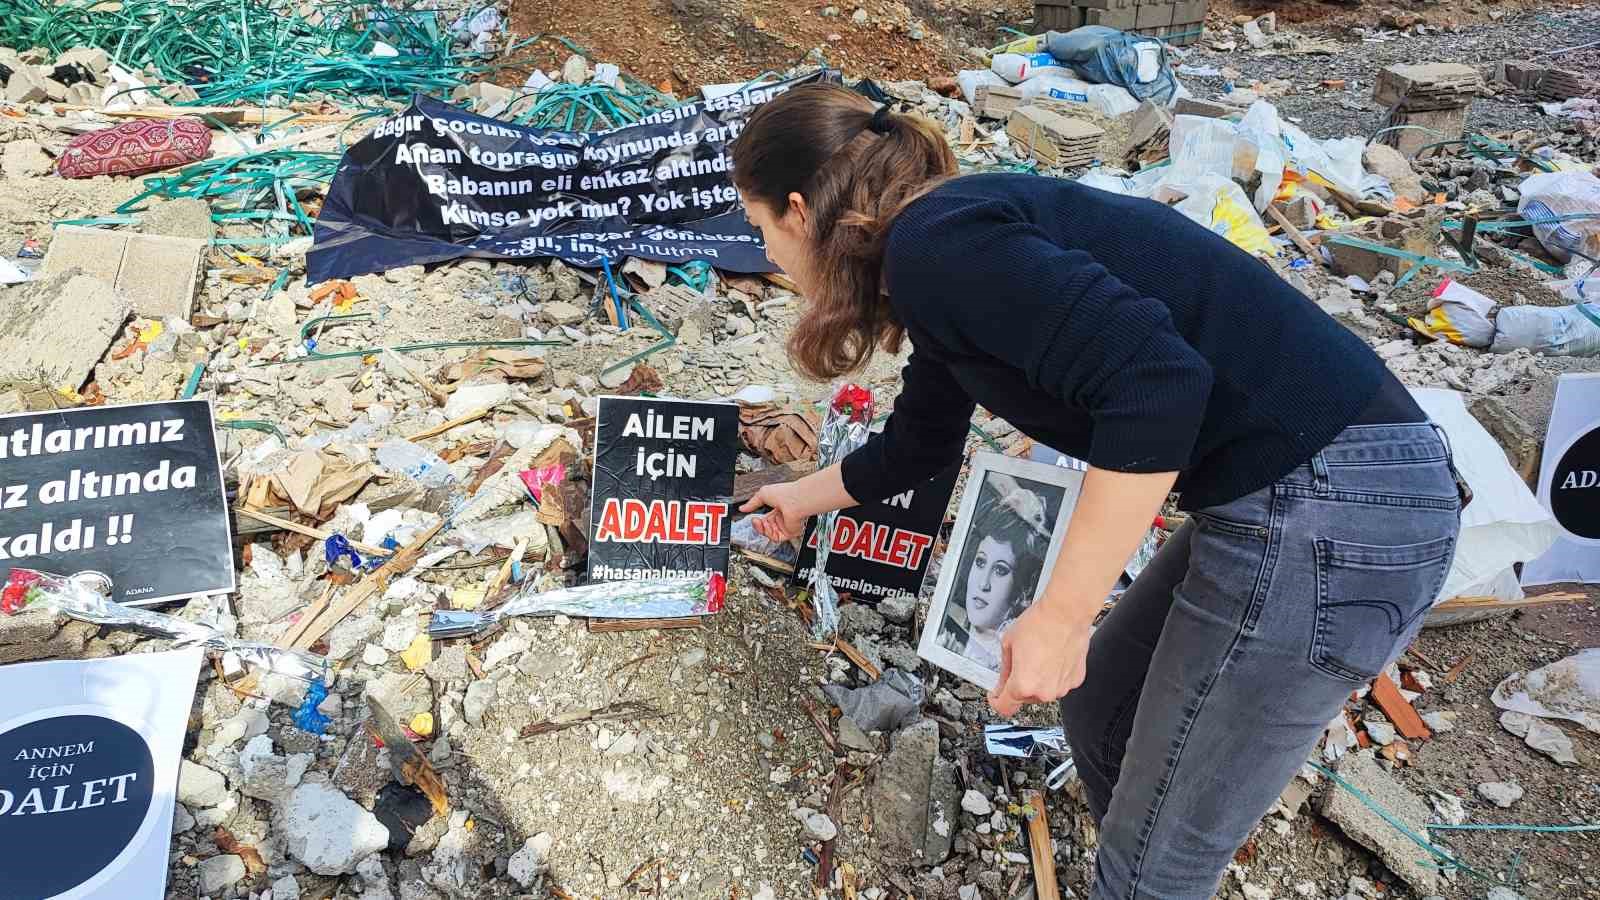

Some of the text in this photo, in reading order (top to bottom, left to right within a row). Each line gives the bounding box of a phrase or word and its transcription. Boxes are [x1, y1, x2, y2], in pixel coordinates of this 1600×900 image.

[395, 143, 461, 165] Anan
[470, 146, 577, 169] toprağın
[584, 130, 699, 163] koynunda
[428, 175, 533, 196] Babanın
[541, 175, 572, 191] eli
[580, 167, 651, 191] enkaz
[440, 200, 521, 227] Kimse
[527, 201, 574, 227] yok
[581, 196, 632, 218] mu?
[638, 188, 686, 212] Yok
[0, 419, 184, 459] tlarımız
[622, 408, 715, 441] AİLEM
[636, 446, 697, 481] İÇİN
[1560, 470, 1600, 489] AD
[38, 460, 197, 505] altında
[106, 513, 135, 546] !!
[595, 498, 729, 545] ADALET
[14, 741, 95, 761] ANNEM
[28, 763, 74, 781] İÇİN
